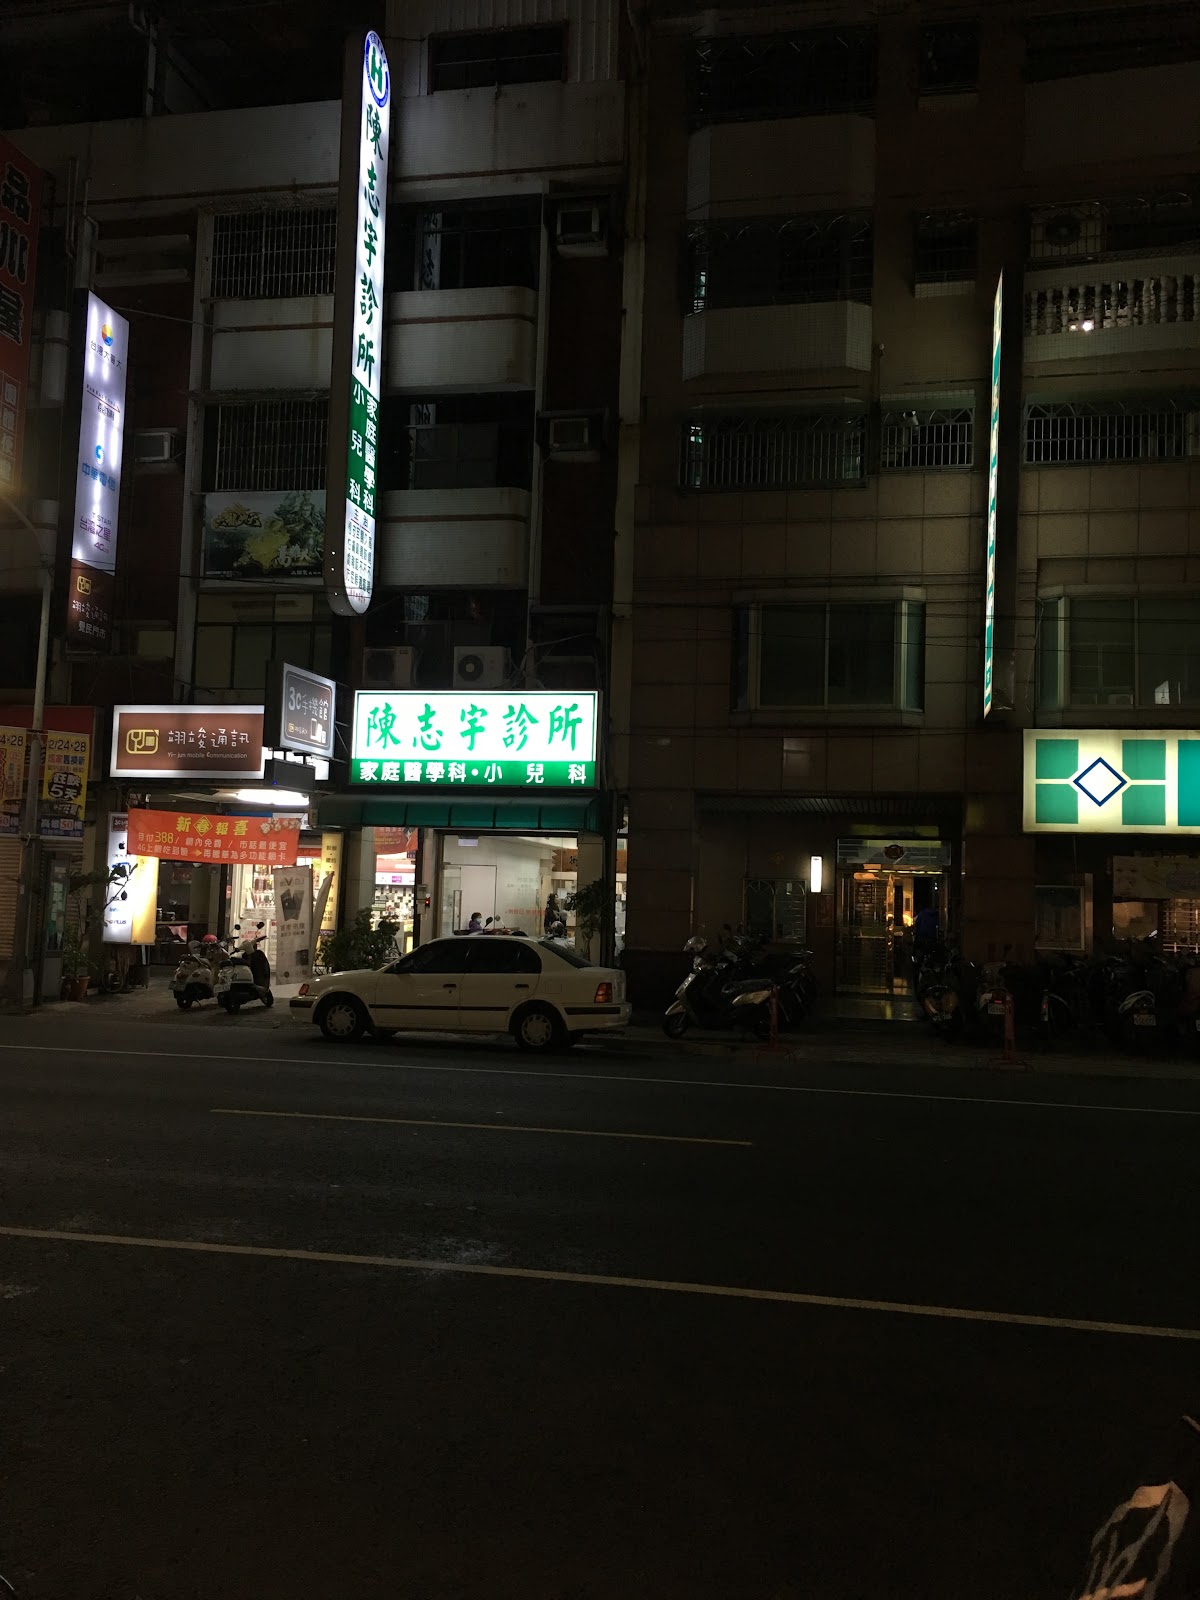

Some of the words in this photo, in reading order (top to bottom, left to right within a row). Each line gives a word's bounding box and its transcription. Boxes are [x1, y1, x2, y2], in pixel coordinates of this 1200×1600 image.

[357, 103, 383, 388] 陳志宇診所
[362, 394, 378, 515] 家庭醫學科
[81, 462, 116, 492] 中華電信
[79, 516, 111, 542] 台灣之星
[366, 702, 583, 751] 陳志宇診所
[176, 815, 249, 836] 新春報喜
[239, 840, 288, 851] 市話最便宜
